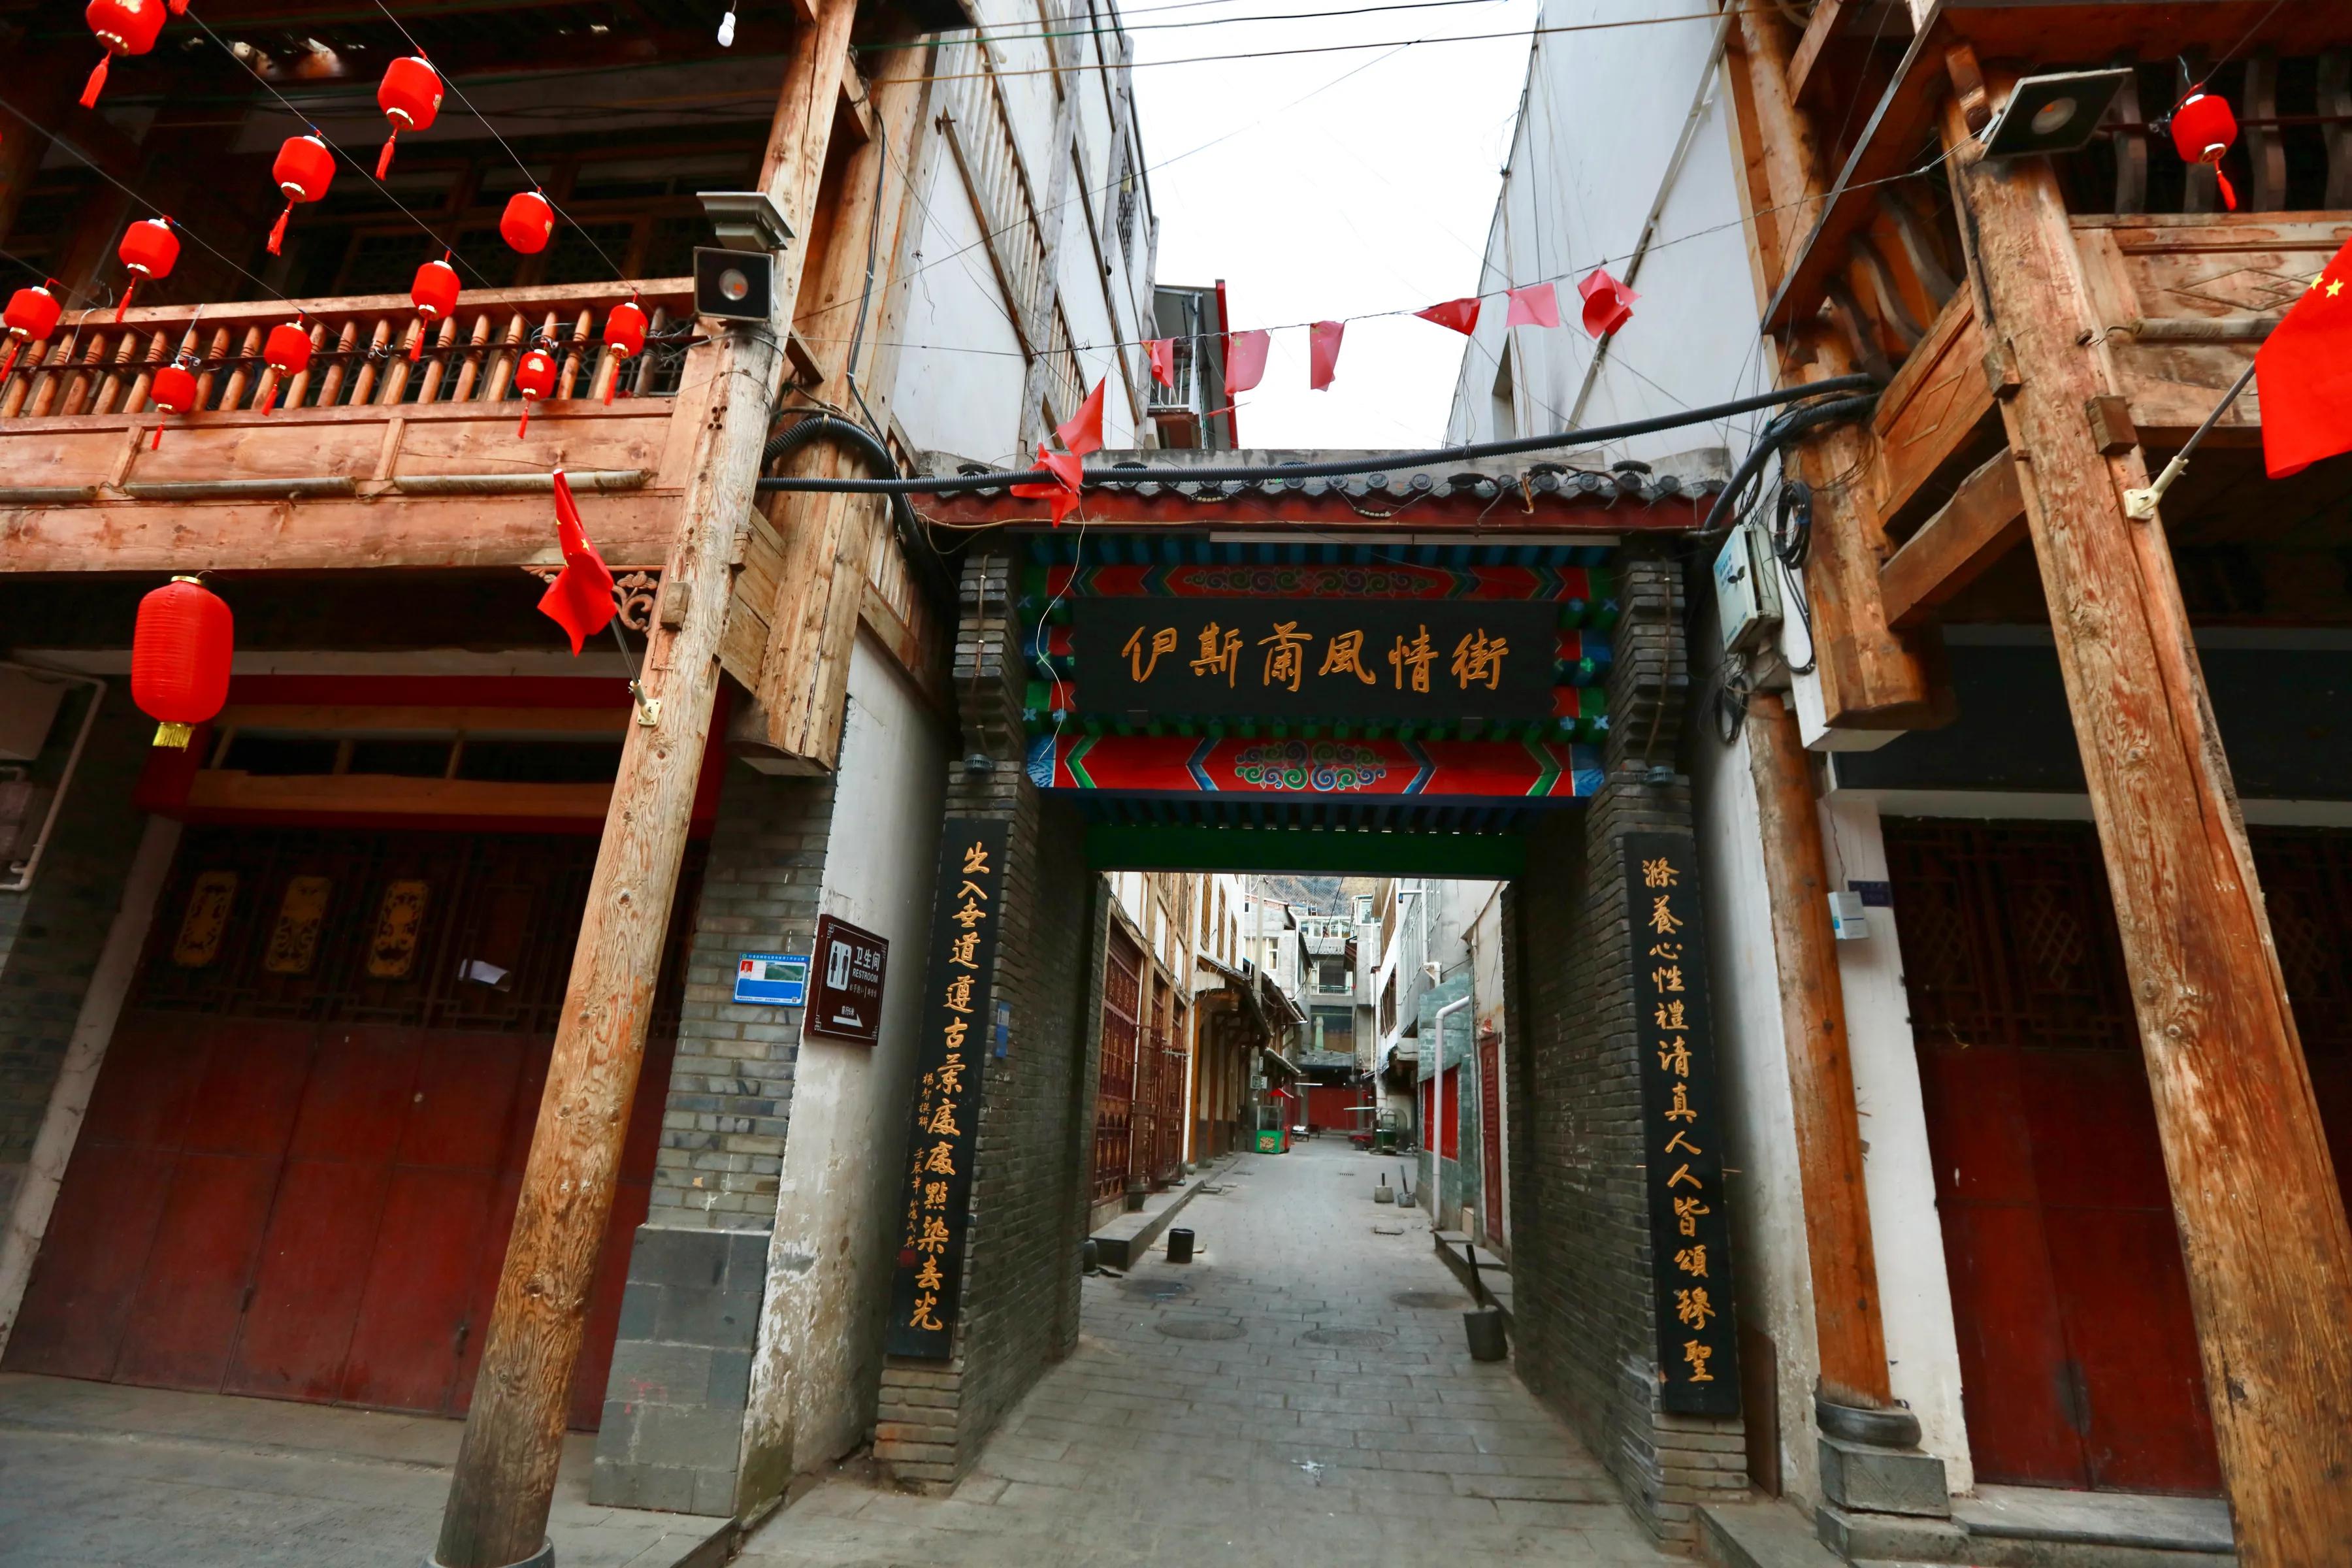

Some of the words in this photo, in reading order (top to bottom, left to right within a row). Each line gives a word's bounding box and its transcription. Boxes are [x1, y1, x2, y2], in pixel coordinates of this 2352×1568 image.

[853, 946, 880, 972] 卫生间
[852, 968, 879, 983] RESTROOM
